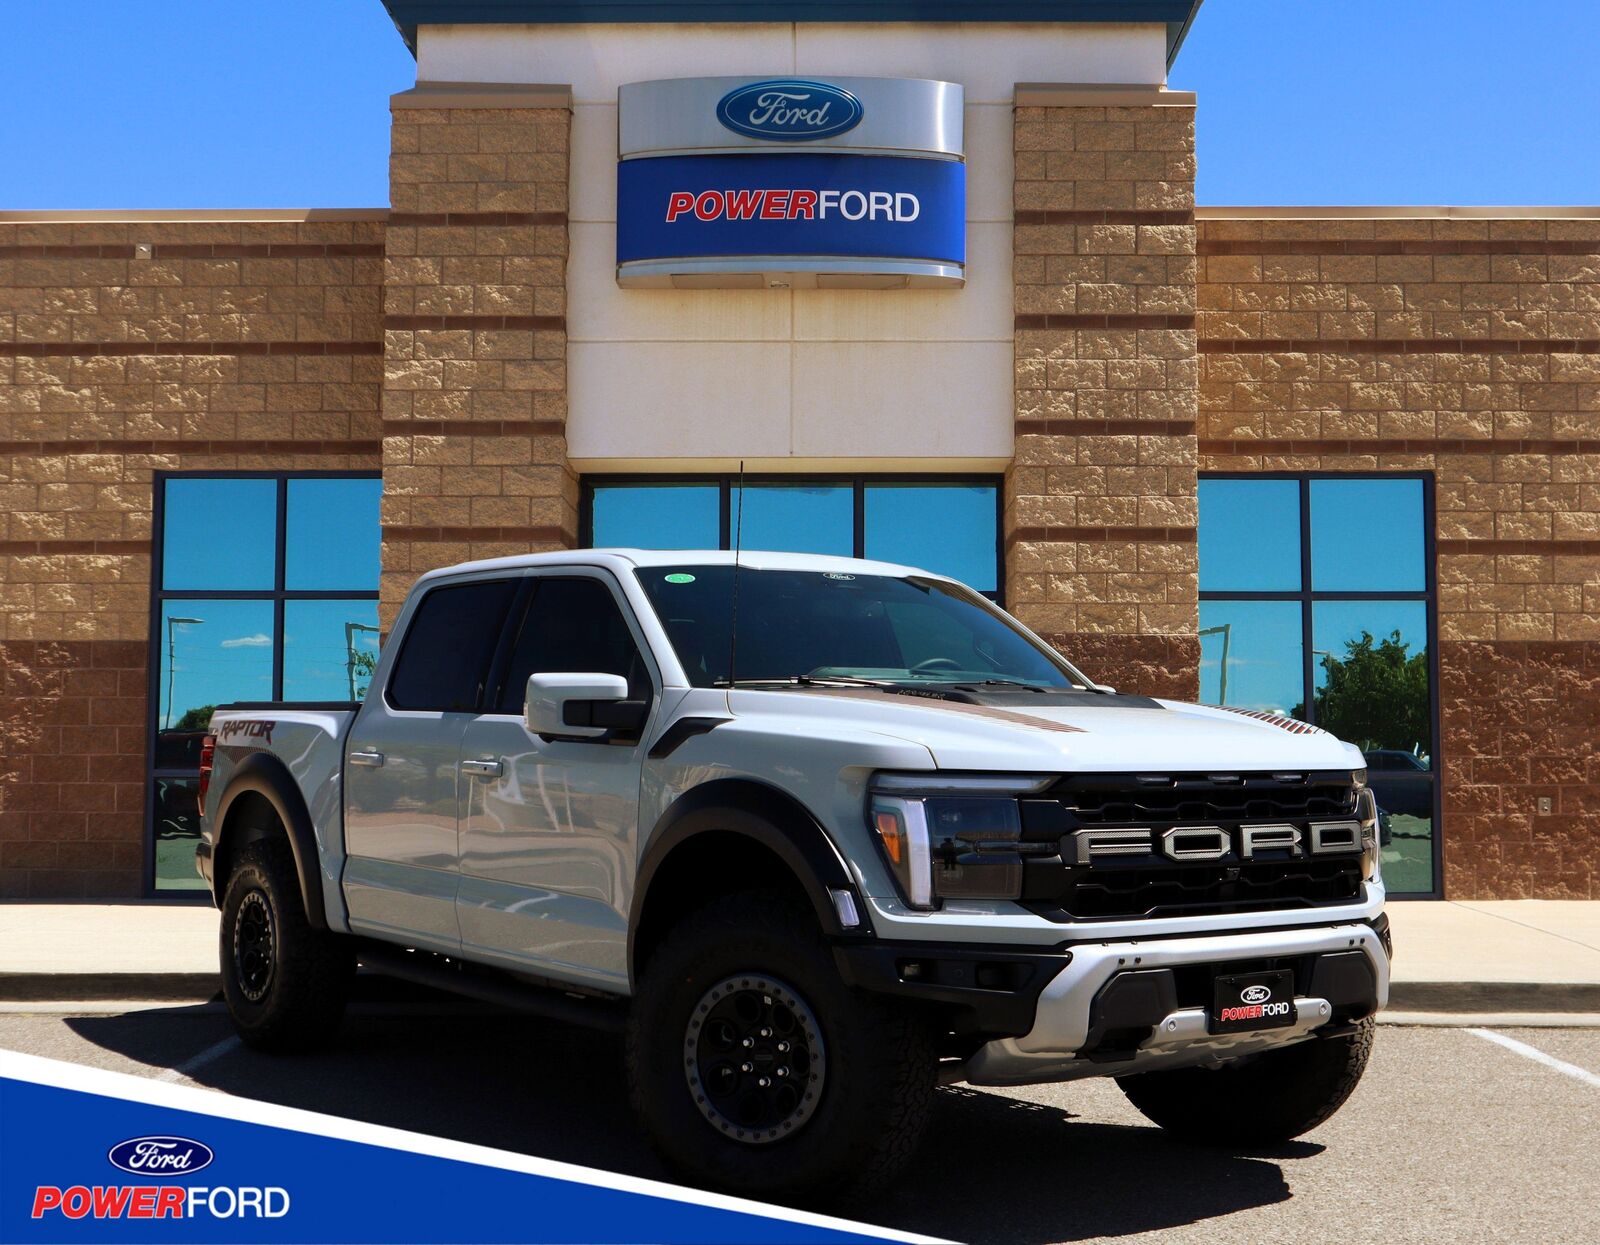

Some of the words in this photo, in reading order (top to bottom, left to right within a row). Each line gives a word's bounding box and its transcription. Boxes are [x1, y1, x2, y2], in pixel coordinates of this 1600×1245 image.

[749, 91, 832, 126] Ford
[220, 719, 277, 746] RAPTOR
[1060, 820, 1363, 866] FORD
[1246, 988, 1265, 1000] Ford
